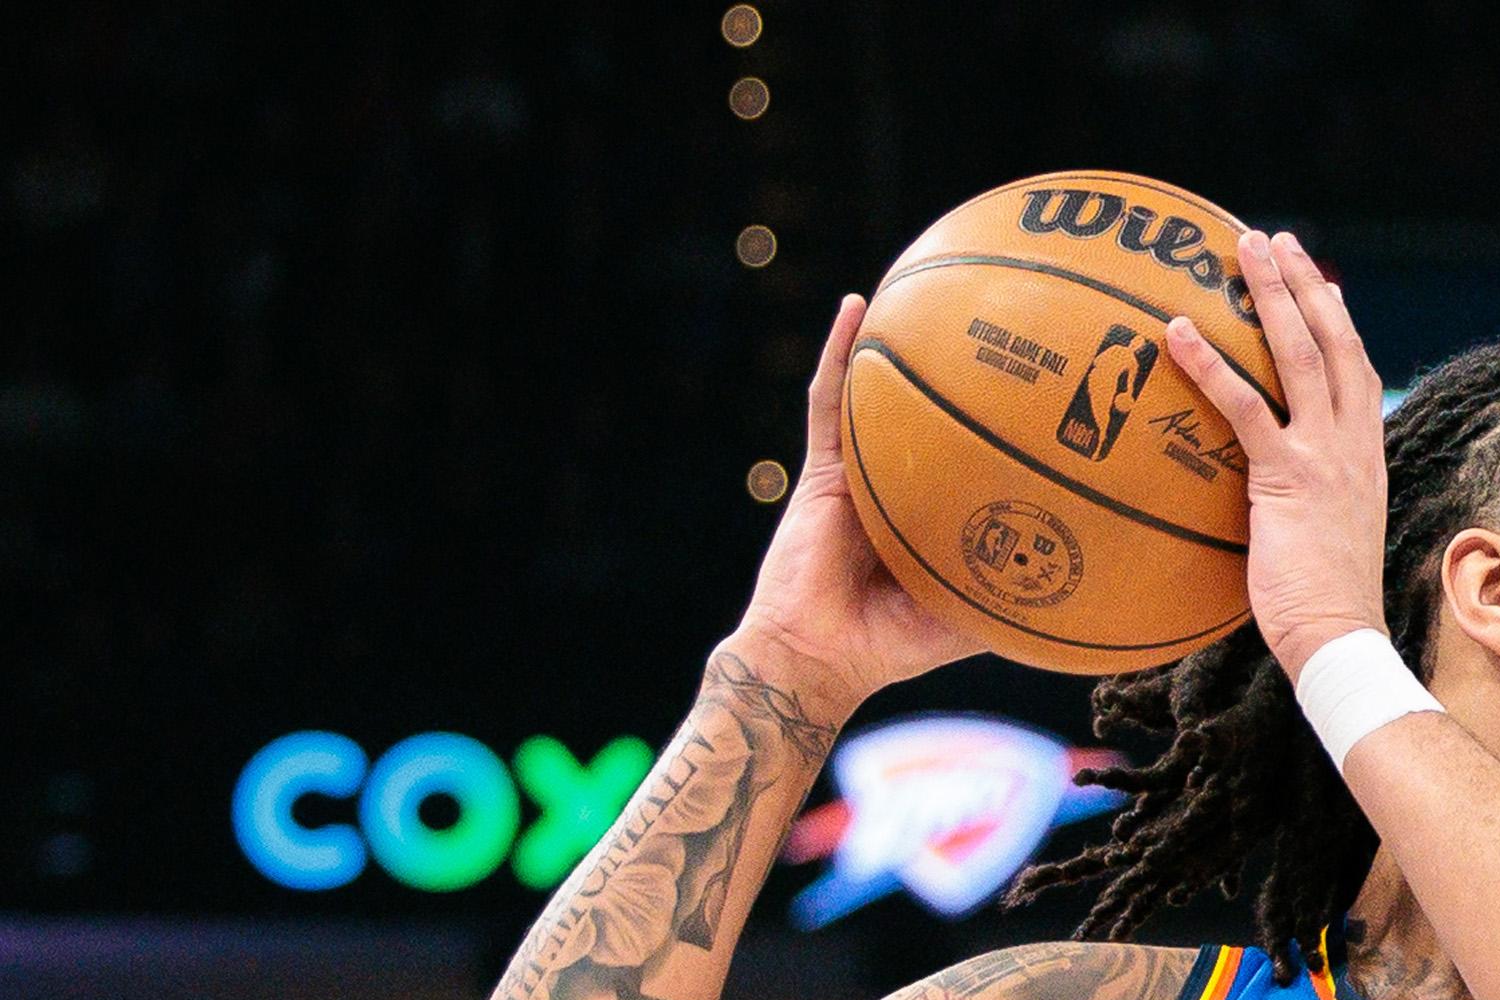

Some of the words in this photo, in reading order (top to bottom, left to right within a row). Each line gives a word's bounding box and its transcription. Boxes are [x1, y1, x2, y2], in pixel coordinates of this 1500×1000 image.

[1018, 188, 1266, 336] Wilso
[967, 317, 1012, 350] OFFICIAL
[1009, 335, 1042, 363] GAME
[1039, 346, 1069, 376] BALL
[1063, 417, 1095, 449] NBA
